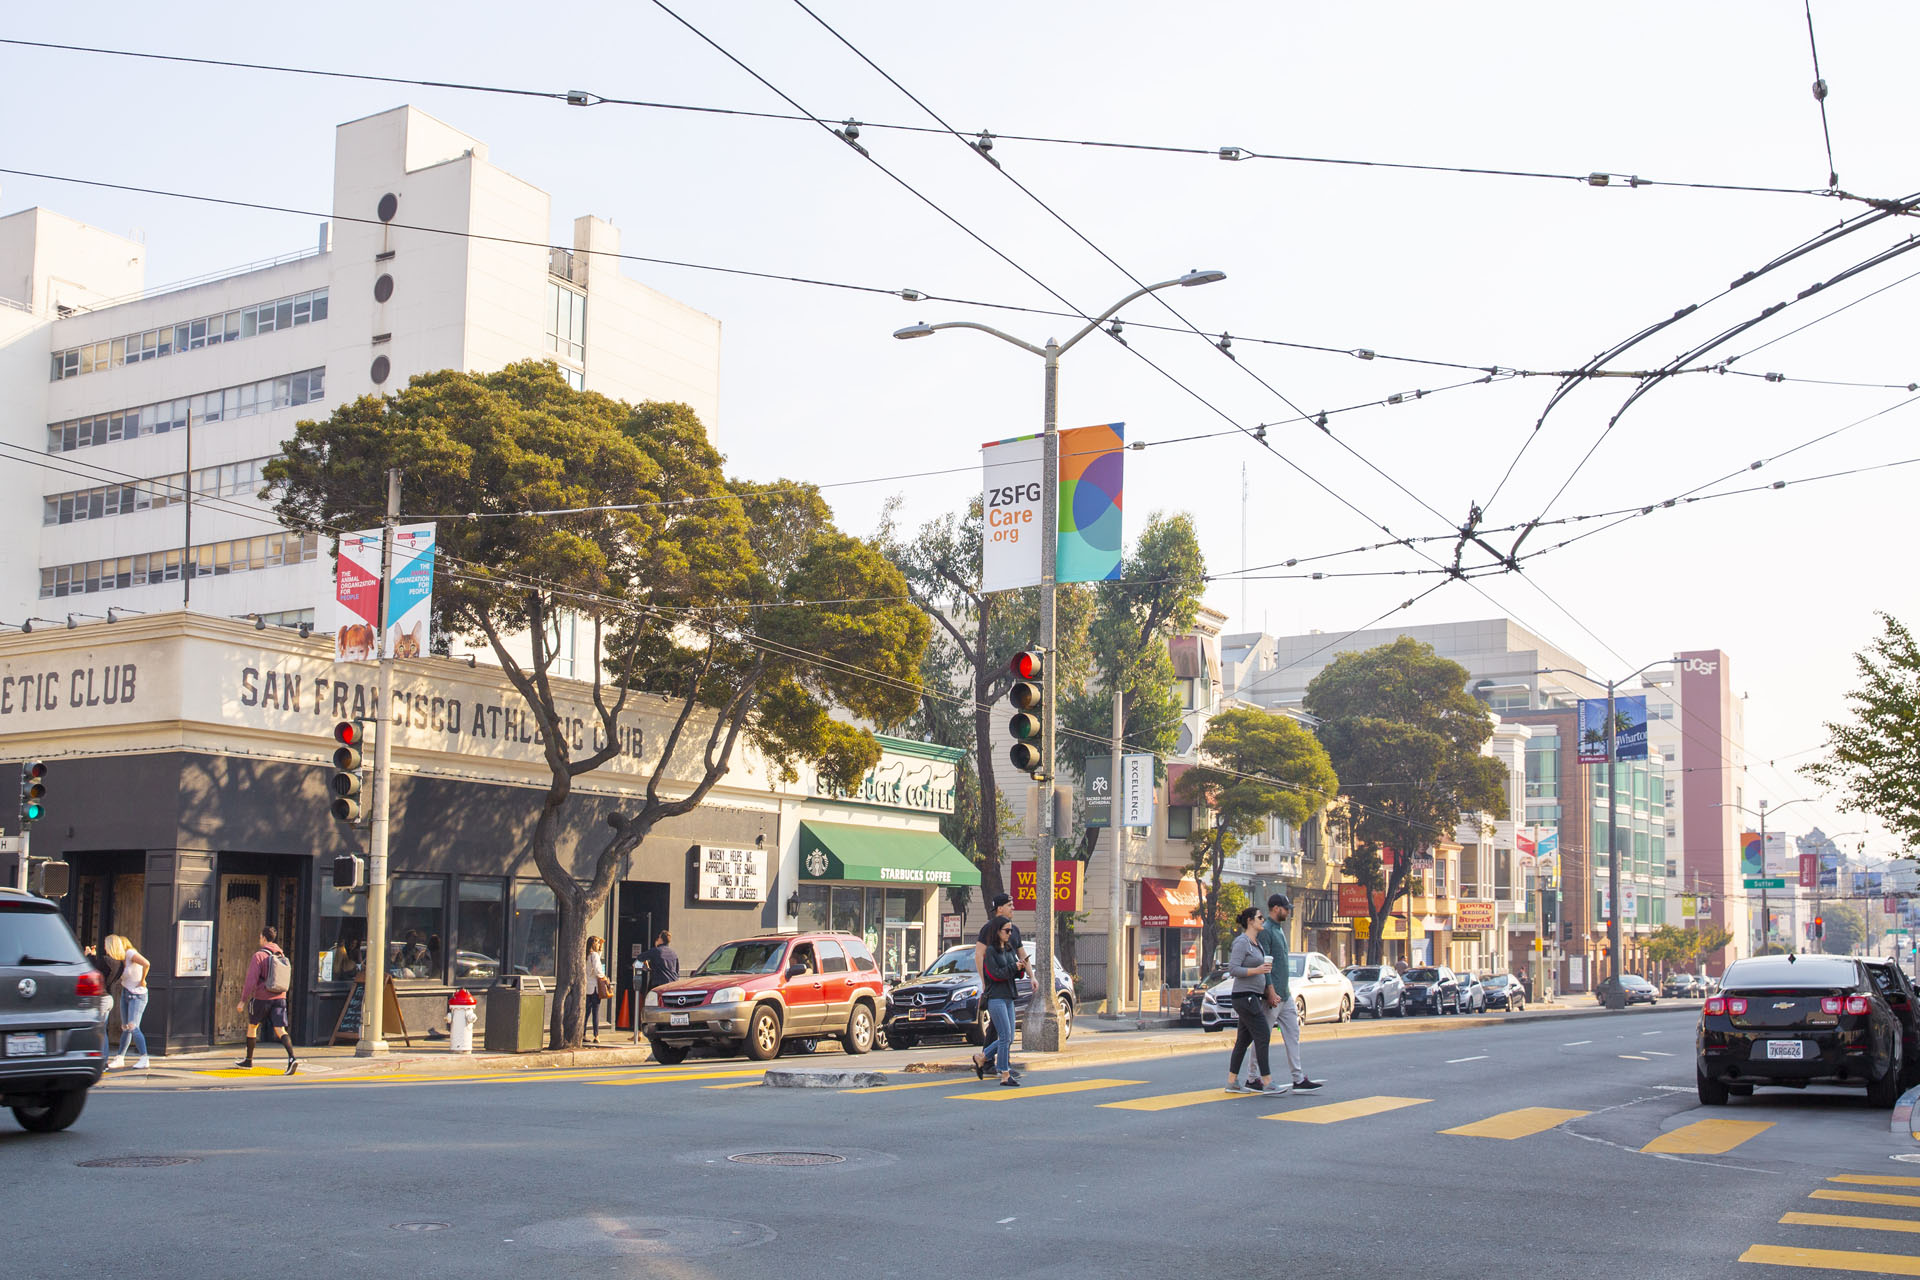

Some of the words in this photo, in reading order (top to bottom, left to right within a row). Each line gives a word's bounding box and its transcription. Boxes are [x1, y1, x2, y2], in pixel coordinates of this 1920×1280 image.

[989, 482, 1041, 507] ZSFG
[989, 508, 1033, 528] Care
[989, 528, 1019, 543] .org
[341, 580, 376, 589] ORGANIZATION
[395, 576, 430, 585] ORGANIZATION
[1683, 657, 1718, 675] UCSF
[70, 663, 136, 708] CLUB
[241, 667, 301, 713] SAN
[593, 721, 643, 758] CUB
[1131, 760, 1139, 821] EXCELLENCE
[705, 861, 730, 874] APPRECIATE
[734, 862, 742, 875] THE
[744, 863, 757, 875] SMALL
[880, 867, 924, 881] STARBUCKS
[925, 870, 951, 882] COFFEE
[710, 886, 719, 899] LIKE
[725, 887, 736, 899] SHOT
